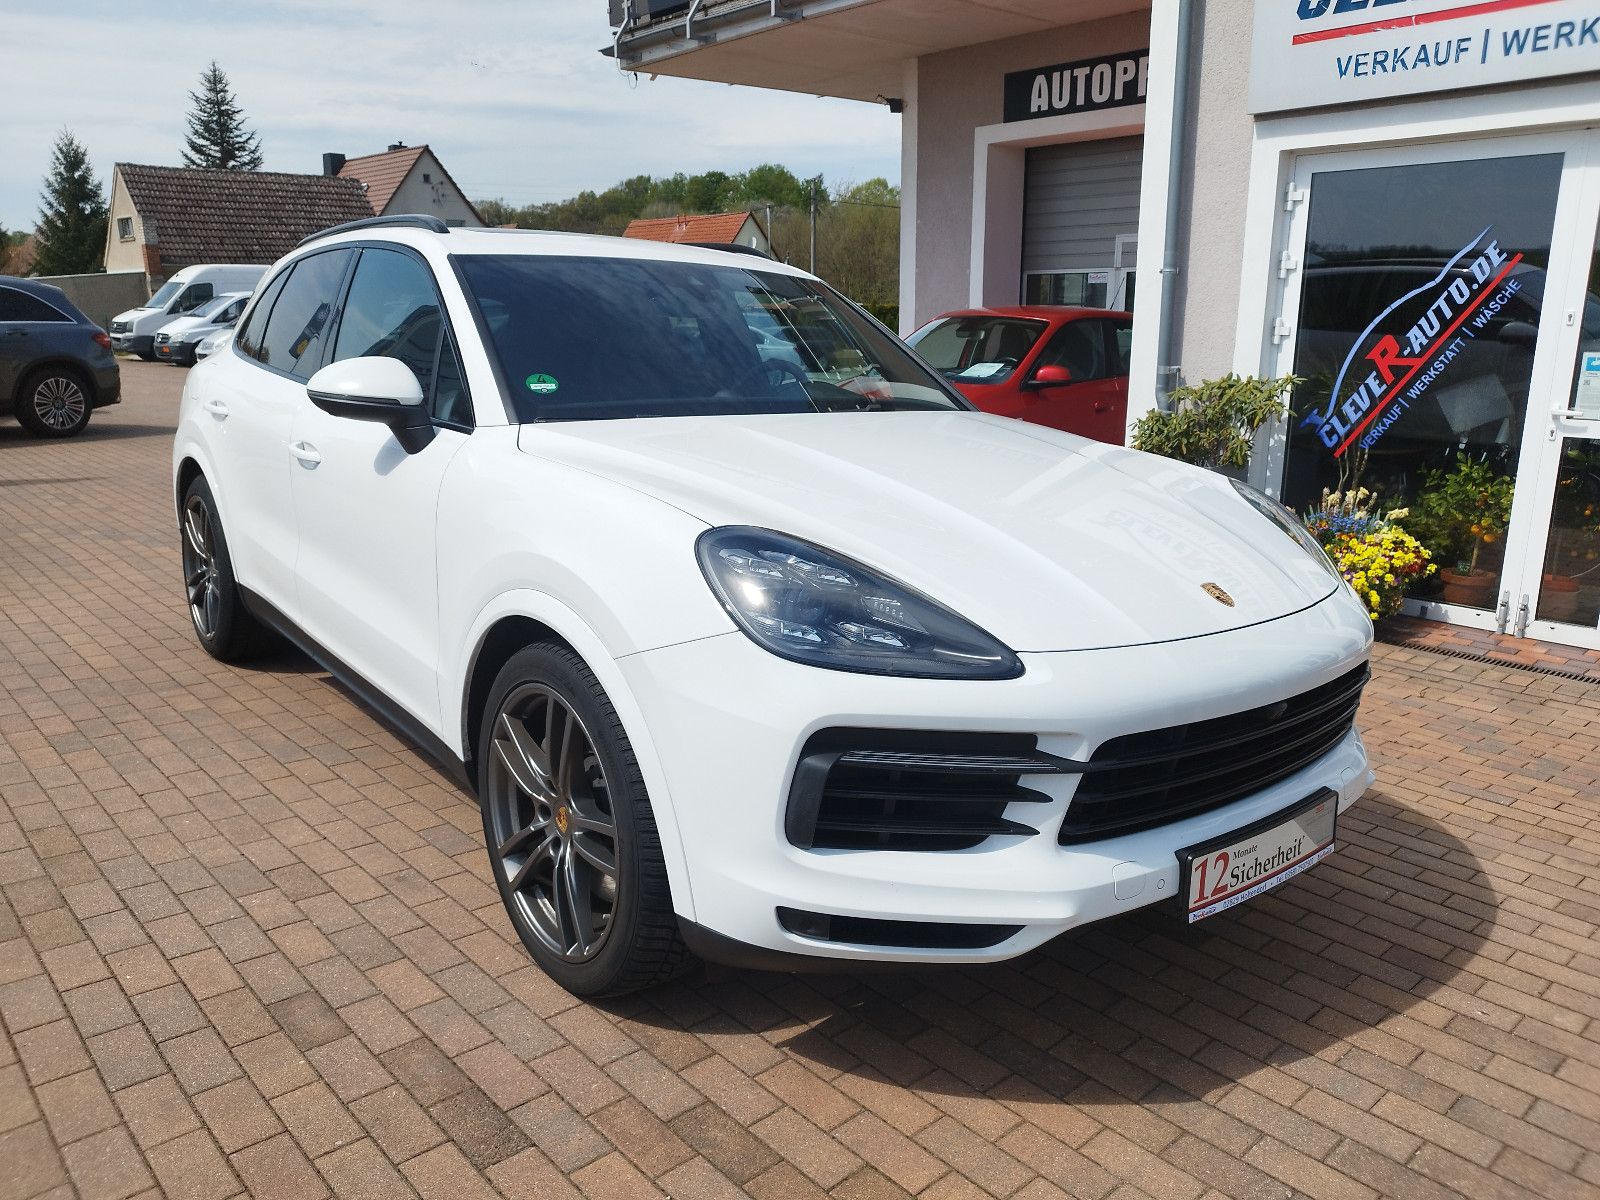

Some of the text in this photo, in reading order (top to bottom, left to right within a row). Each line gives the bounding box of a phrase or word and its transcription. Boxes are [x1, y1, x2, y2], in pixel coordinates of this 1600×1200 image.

[1336, 16, 1600, 79] VERKAUF WERK
[1360, 278, 1523, 450] VERKAUF WERKSTATT WÄSCHE
[1193, 851, 1230, 904] 12
[1229, 837, 1302, 888] Sicherheit
[1232, 844, 1258, 861] Monate
